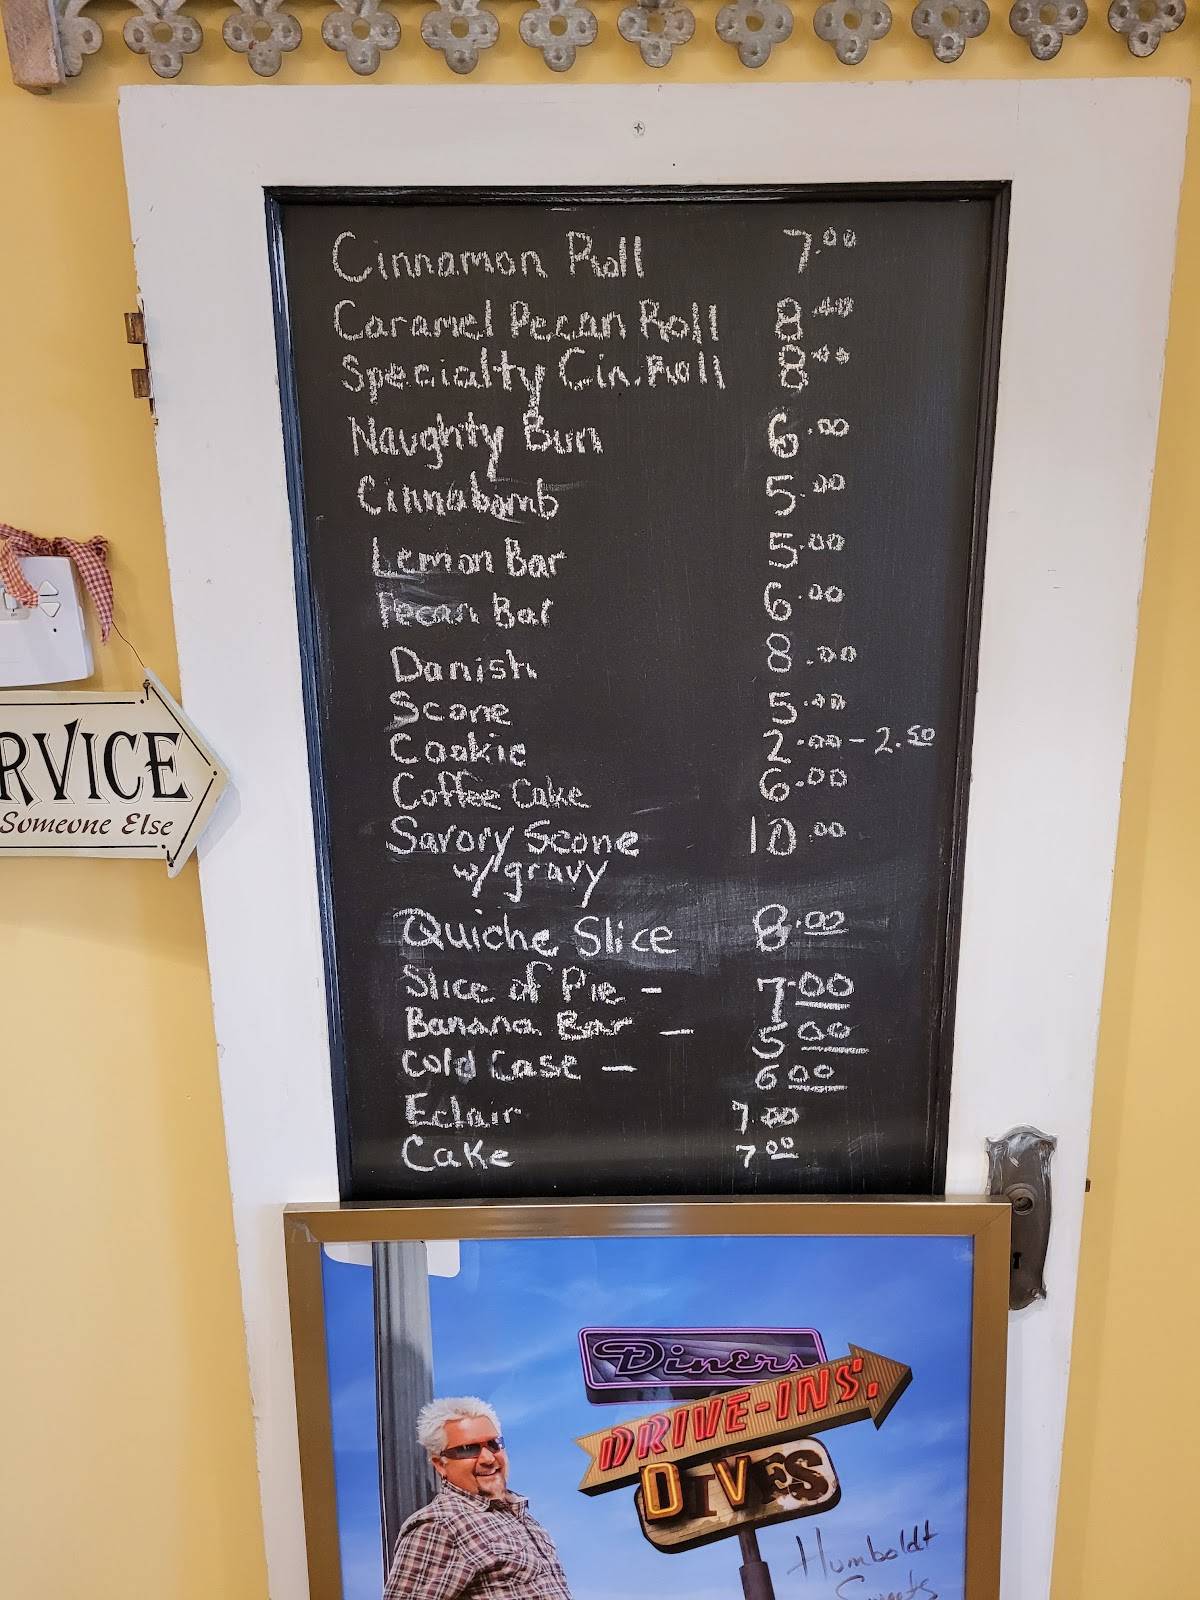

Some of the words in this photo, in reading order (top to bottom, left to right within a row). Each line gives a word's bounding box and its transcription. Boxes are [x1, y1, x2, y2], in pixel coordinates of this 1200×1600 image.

[332, 231, 548, 282] Cinnamon
[565, 230, 645, 278] Roll
[783, 226, 857, 274] 7.00
[333, 299, 494, 341] Caramel
[509, 299, 627, 341] Pecan
[639, 298, 720, 343] Roll
[341, 346, 547, 413] Specialty
[643, 350, 726, 390] Roll
[348, 411, 505, 482] Naughty
[522, 412, 604, 454] Bun
[767, 411, 850, 459] 6.00
[357, 471, 560, 522] Cinnabomb
[766, 473, 846, 517] 5.00
[371, 536, 495, 578] Lemon
[504, 536, 568, 579] Bar
[768, 531, 846, 569] 5.00
[377, 591, 481, 628] Pecan
[492, 592, 554, 629] Bar
[764, 581, 846, 622] 6.00
[389, 646, 538, 684] Danish
[766, 632, 857, 674] 8.00
[387, 690, 512, 727] Scone
[768, 691, 847, 725] 5.00
[389, 731, 528, 768] Cookie
[391, 769, 502, 811] Coffee
[510, 774, 593, 810] Cake
[759, 766, 848, 802] 6.00
[0, 810, 112, 836] Someone
[121, 812, 175, 837] Else
[385, 815, 515, 874] Savory
[523, 818, 641, 857] Scone
[750, 815, 848, 857] 10.00
[393, 907, 560, 958] Quiche
[572, 914, 680, 959] Slice
[752, 903, 850, 952] 8.00
[402, 963, 497, 1005] Slice
[507, 959, 554, 1004] of
[561, 965, 627, 1005] Pie
[403, 1005, 543, 1042] Banana
[556, 1008, 634, 1041] Bar
[401, 1047, 478, 1080] Cold
[490, 1048, 582, 1082] Case
[404, 1091, 522, 1129] Eclair
[400, 1133, 516, 1173] Cake
[786, 1518, 940, 1580] Humboldt
